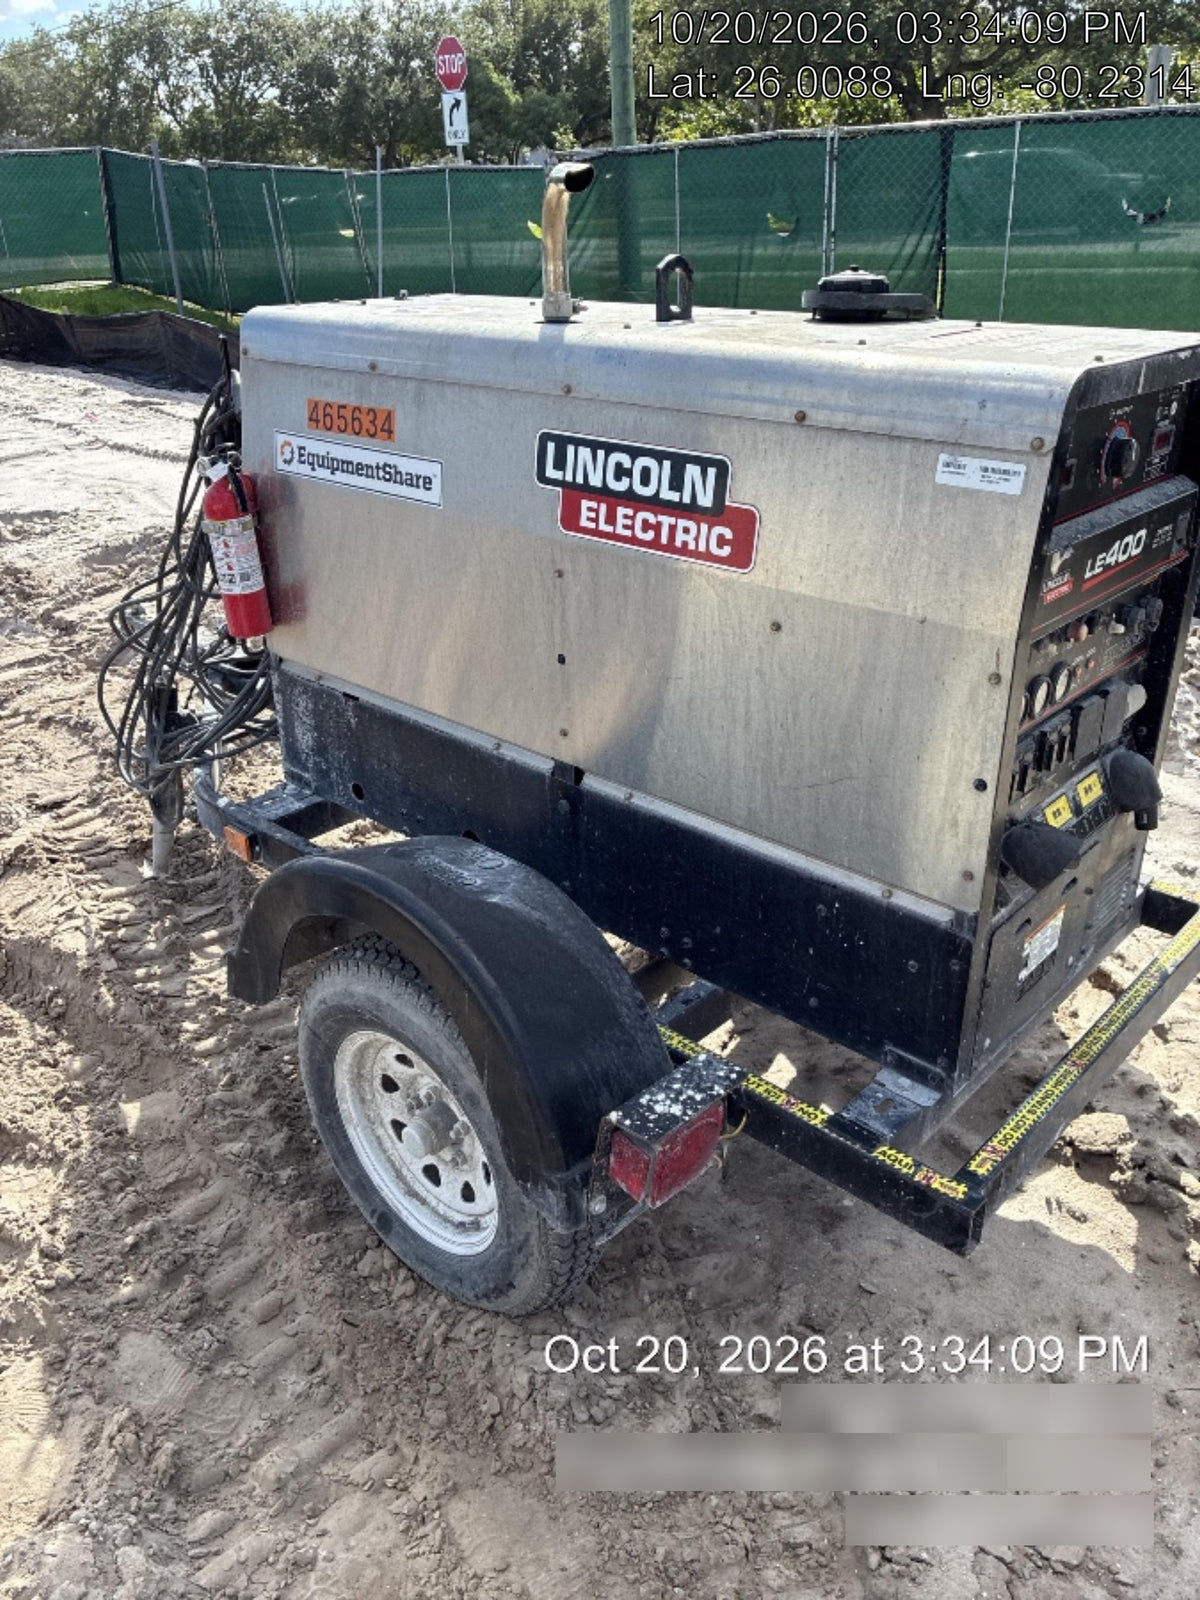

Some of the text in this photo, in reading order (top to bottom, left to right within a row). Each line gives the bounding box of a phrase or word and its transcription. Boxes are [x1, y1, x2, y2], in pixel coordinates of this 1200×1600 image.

[438, 53, 465, 75] STOP
[307, 401, 395, 440] 465634
[296, 445, 433, 491] EquipmentShare
[545, 441, 717, 508] LINCOLN
[579, 499, 733, 557] ELECTRIC
[1084, 527, 1148, 580] LE400
[997, 1131, 1015, 1148] DO
[1026, 1088, 1056, 1117] STAND
